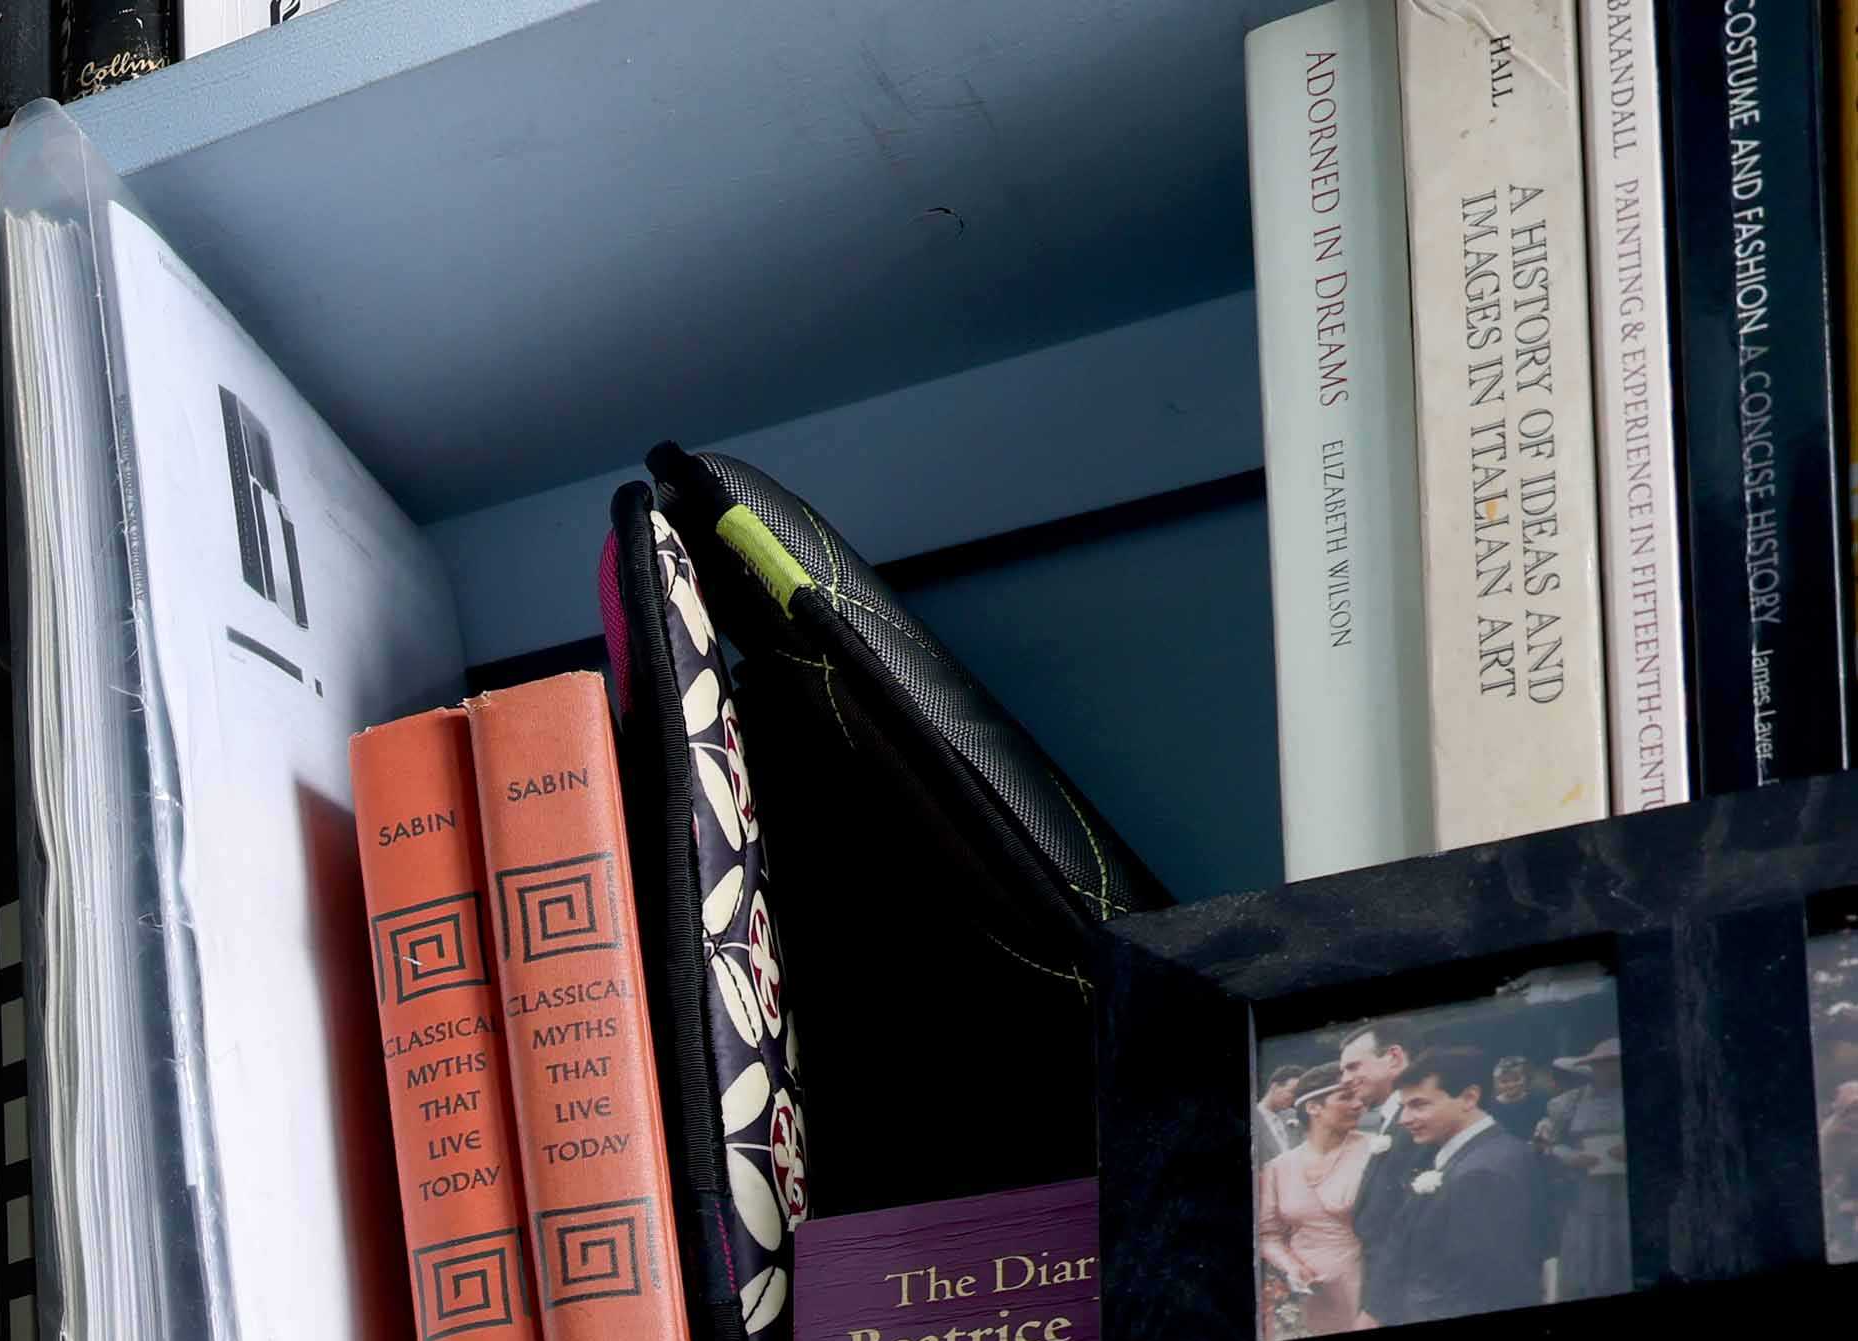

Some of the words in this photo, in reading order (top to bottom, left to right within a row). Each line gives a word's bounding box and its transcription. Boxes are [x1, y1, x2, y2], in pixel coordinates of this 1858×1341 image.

[1489, 34, 1516, 108] HALL
[1306, 49, 1340, 215] ADORNED
[1509, 181, 1545, 215] A
[1312, 225, 1342, 262] IN
[1461, 189, 1502, 351] IMAGES
[1314, 272, 1350, 407] DREAMS
[1510, 222, 1553, 395] HISTORY
[1468, 364, 1504, 408] IN
[1519, 408, 1555, 459] OF
[1321, 438, 1348, 558] ELIZABETH
[1470, 417, 1512, 598] ITALIAN
[1520, 474, 1560, 596] IDEAS
[1327, 560, 1354, 650] WILSON
[1478, 617, 1516, 697] ART
[1524, 607, 1566, 705] AND
[507, 768, 589, 801] SABIN
[505, 978, 634, 1021] CLASSICAL
[532, 1018, 617, 1051] MYTHS
[545, 1056, 613, 1086] THAT
[555, 1096, 613, 1125] LIVE
[542, 1132, 631, 1166] TODAY
[884, 1265, 978, 1309] The
